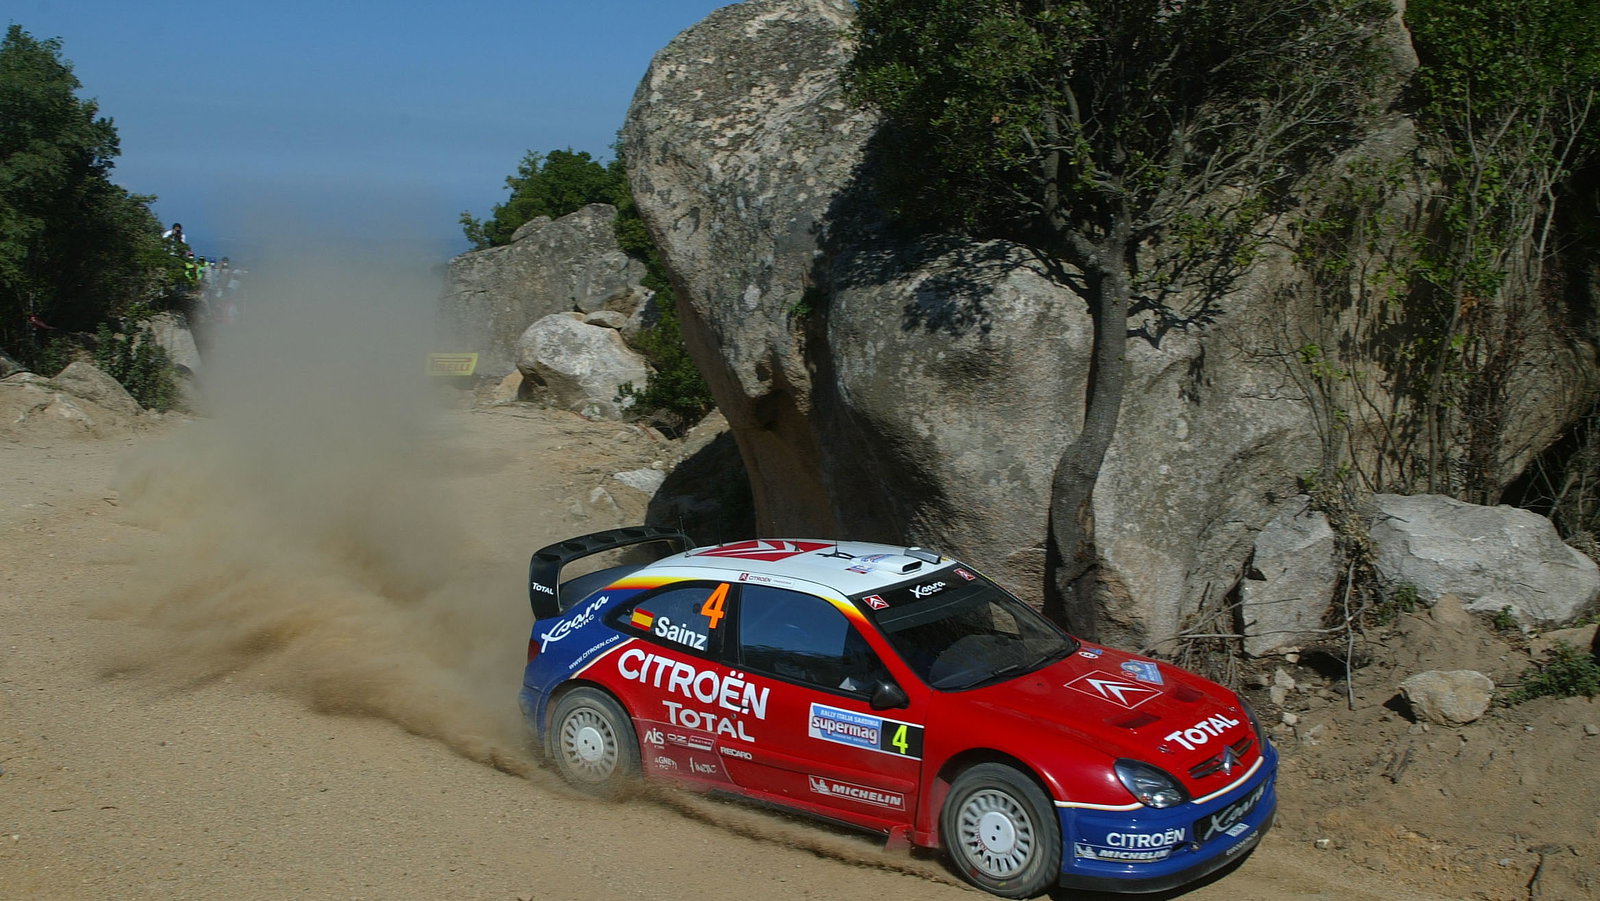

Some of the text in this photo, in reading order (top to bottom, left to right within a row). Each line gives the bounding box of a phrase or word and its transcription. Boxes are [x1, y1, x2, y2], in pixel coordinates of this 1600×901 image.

[532, 582, 555, 596] TOTAL
[909, 581, 946, 599] Xsara
[701, 582, 730, 629] 4
[541, 596, 609, 653] Xsara
[655, 616, 707, 651] Sainz
[617, 648, 770, 720] CITROËN
[662, 700, 755, 743] TOTAL
[812, 716, 878, 744] supermag
[1164, 713, 1239, 750] TOTAL
[720, 746, 753, 760] RECARO
[892, 725, 908, 754] 4
[832, 784, 902, 805] MICHELIN
[1106, 828, 1186, 848] CITROËN
[1099, 848, 1171, 860] MICHELIN
